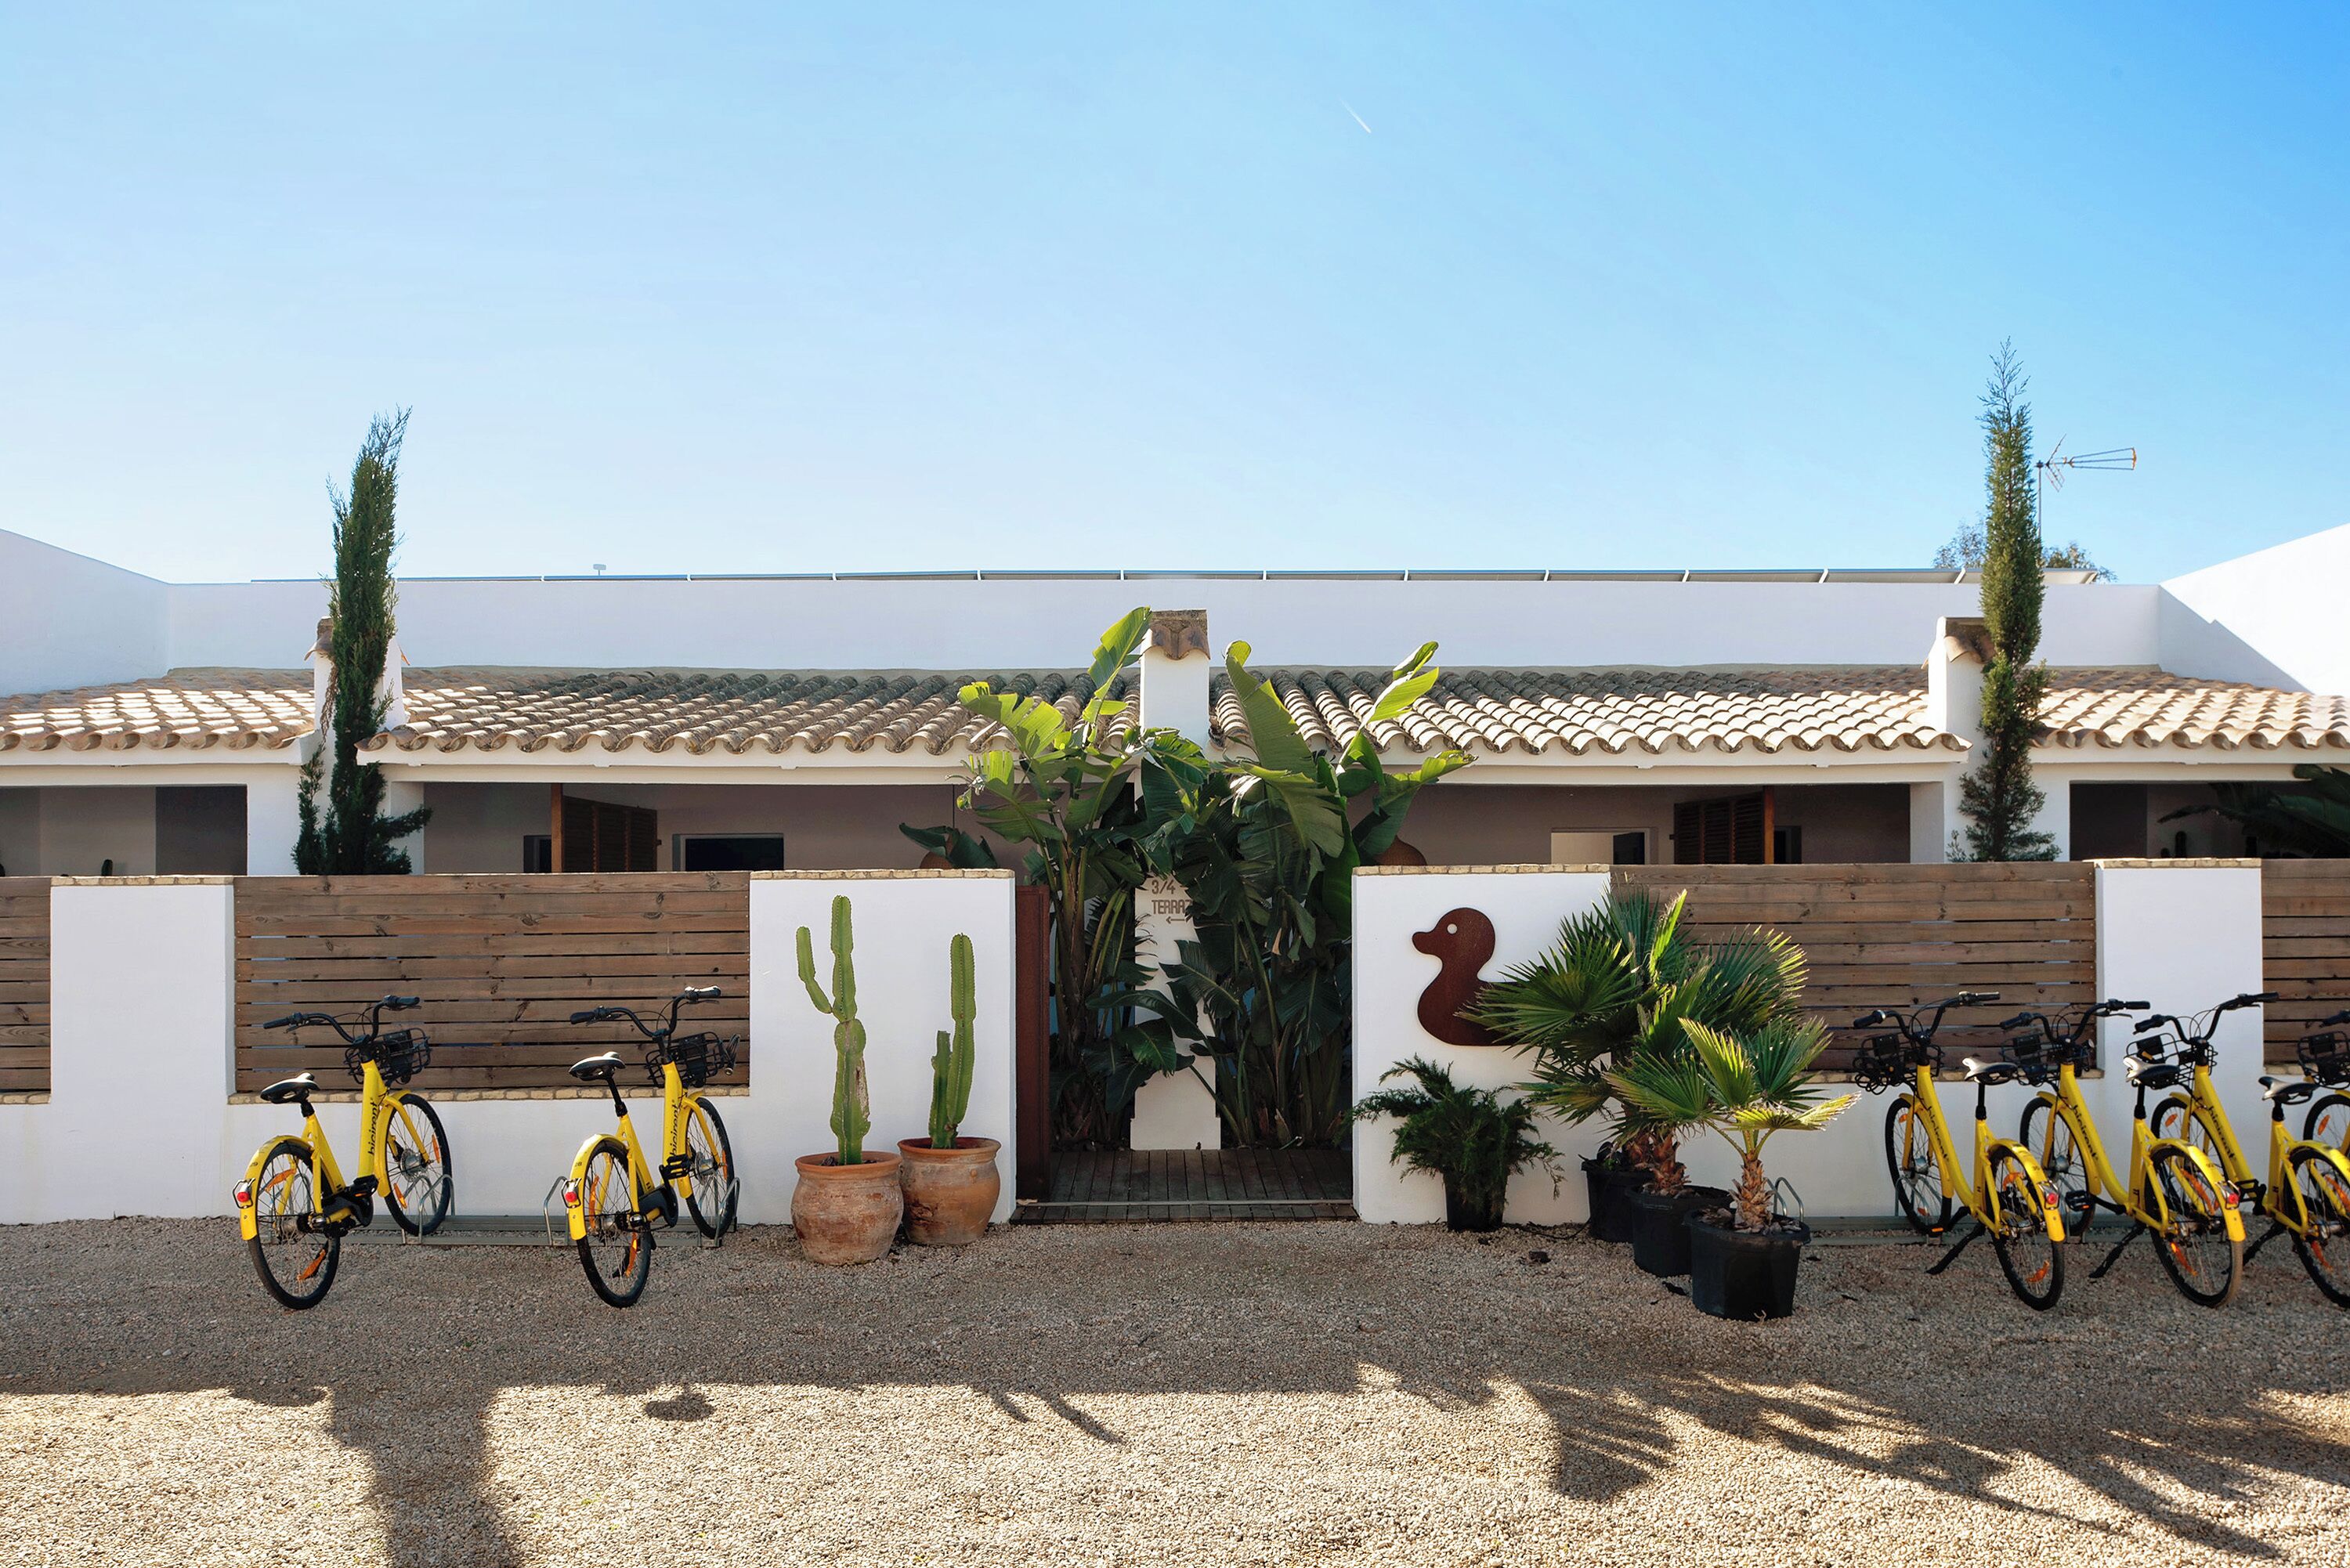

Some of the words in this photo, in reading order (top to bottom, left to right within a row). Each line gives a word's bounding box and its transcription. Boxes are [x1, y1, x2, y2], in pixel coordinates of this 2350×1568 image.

[1152, 879, 1176, 894] 3/4
[367, 1100, 378, 1155] bicirent
[670, 1104, 679, 1156] bicirent
